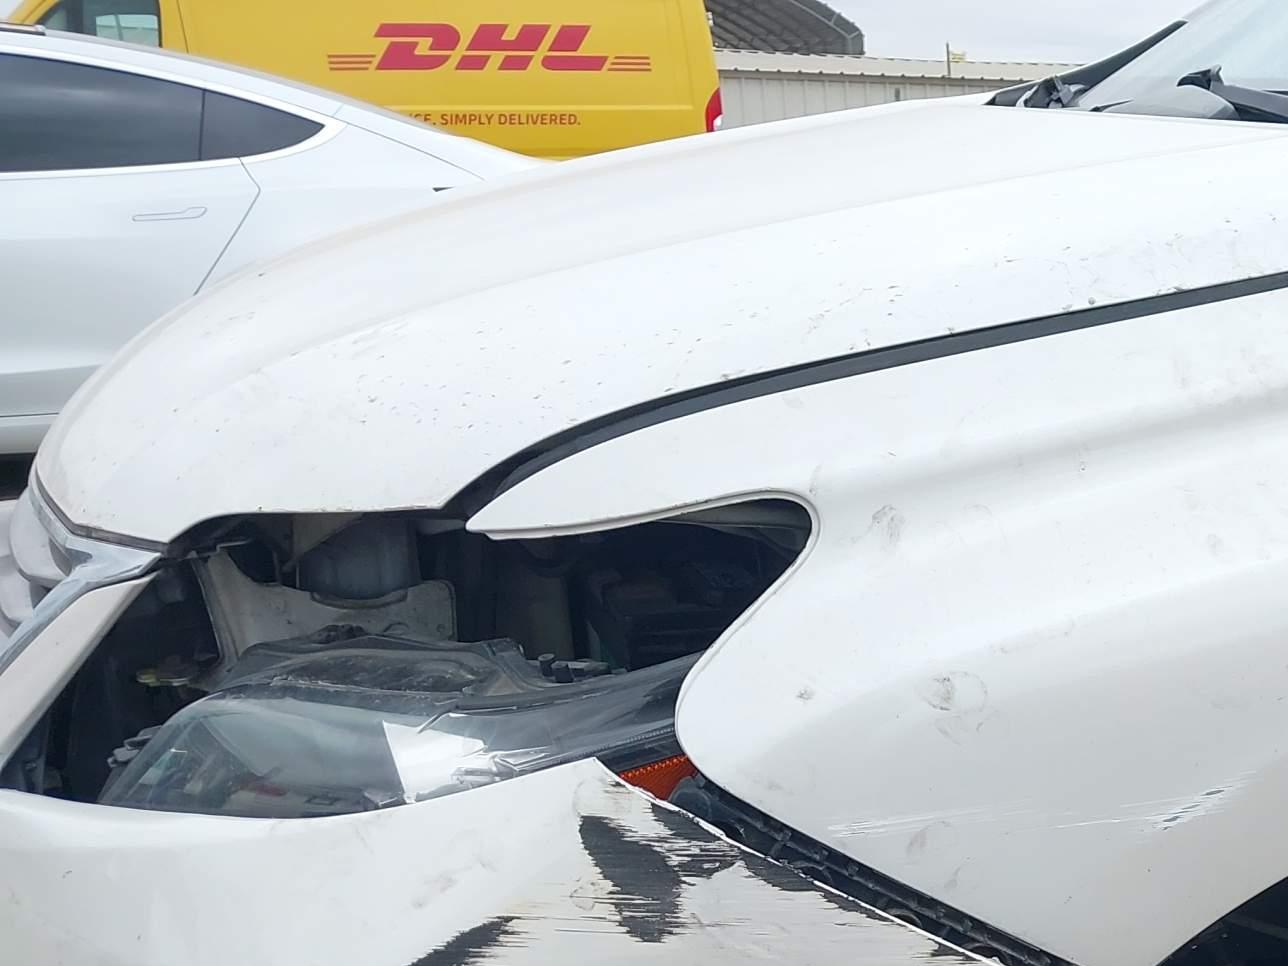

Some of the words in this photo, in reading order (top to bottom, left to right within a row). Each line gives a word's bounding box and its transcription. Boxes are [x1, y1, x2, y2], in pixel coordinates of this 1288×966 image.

[373, 23, 609, 72] DHL
[440, 112, 495, 126] SIMPLY
[497, 112, 582, 126] DELIVERED.
